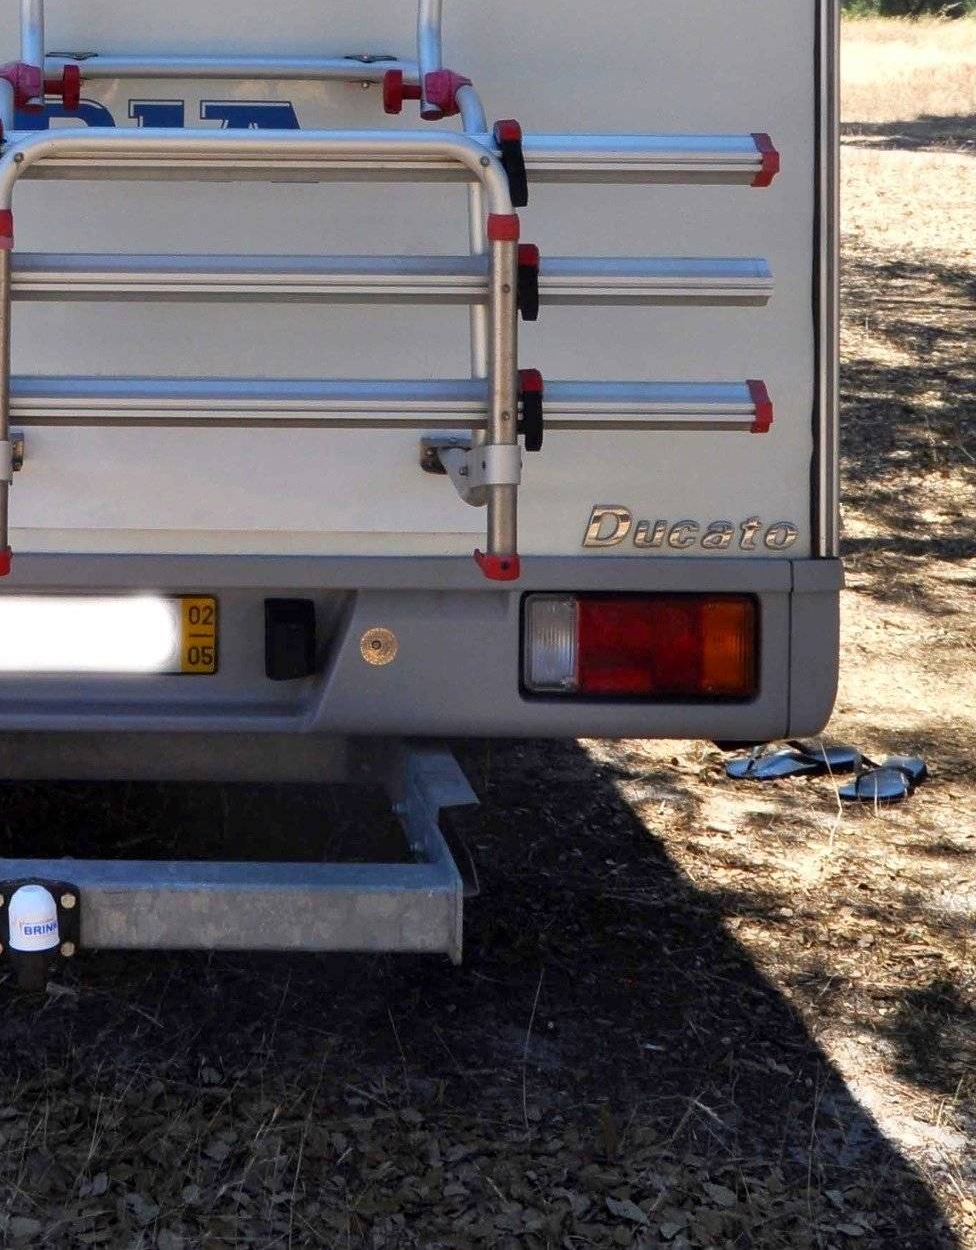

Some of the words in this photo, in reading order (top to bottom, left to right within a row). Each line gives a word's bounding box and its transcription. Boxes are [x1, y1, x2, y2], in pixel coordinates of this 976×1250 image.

[582, 504, 800, 551] Ducato
[187, 605, 214, 626] 02
[187, 645, 214, 666] 05
